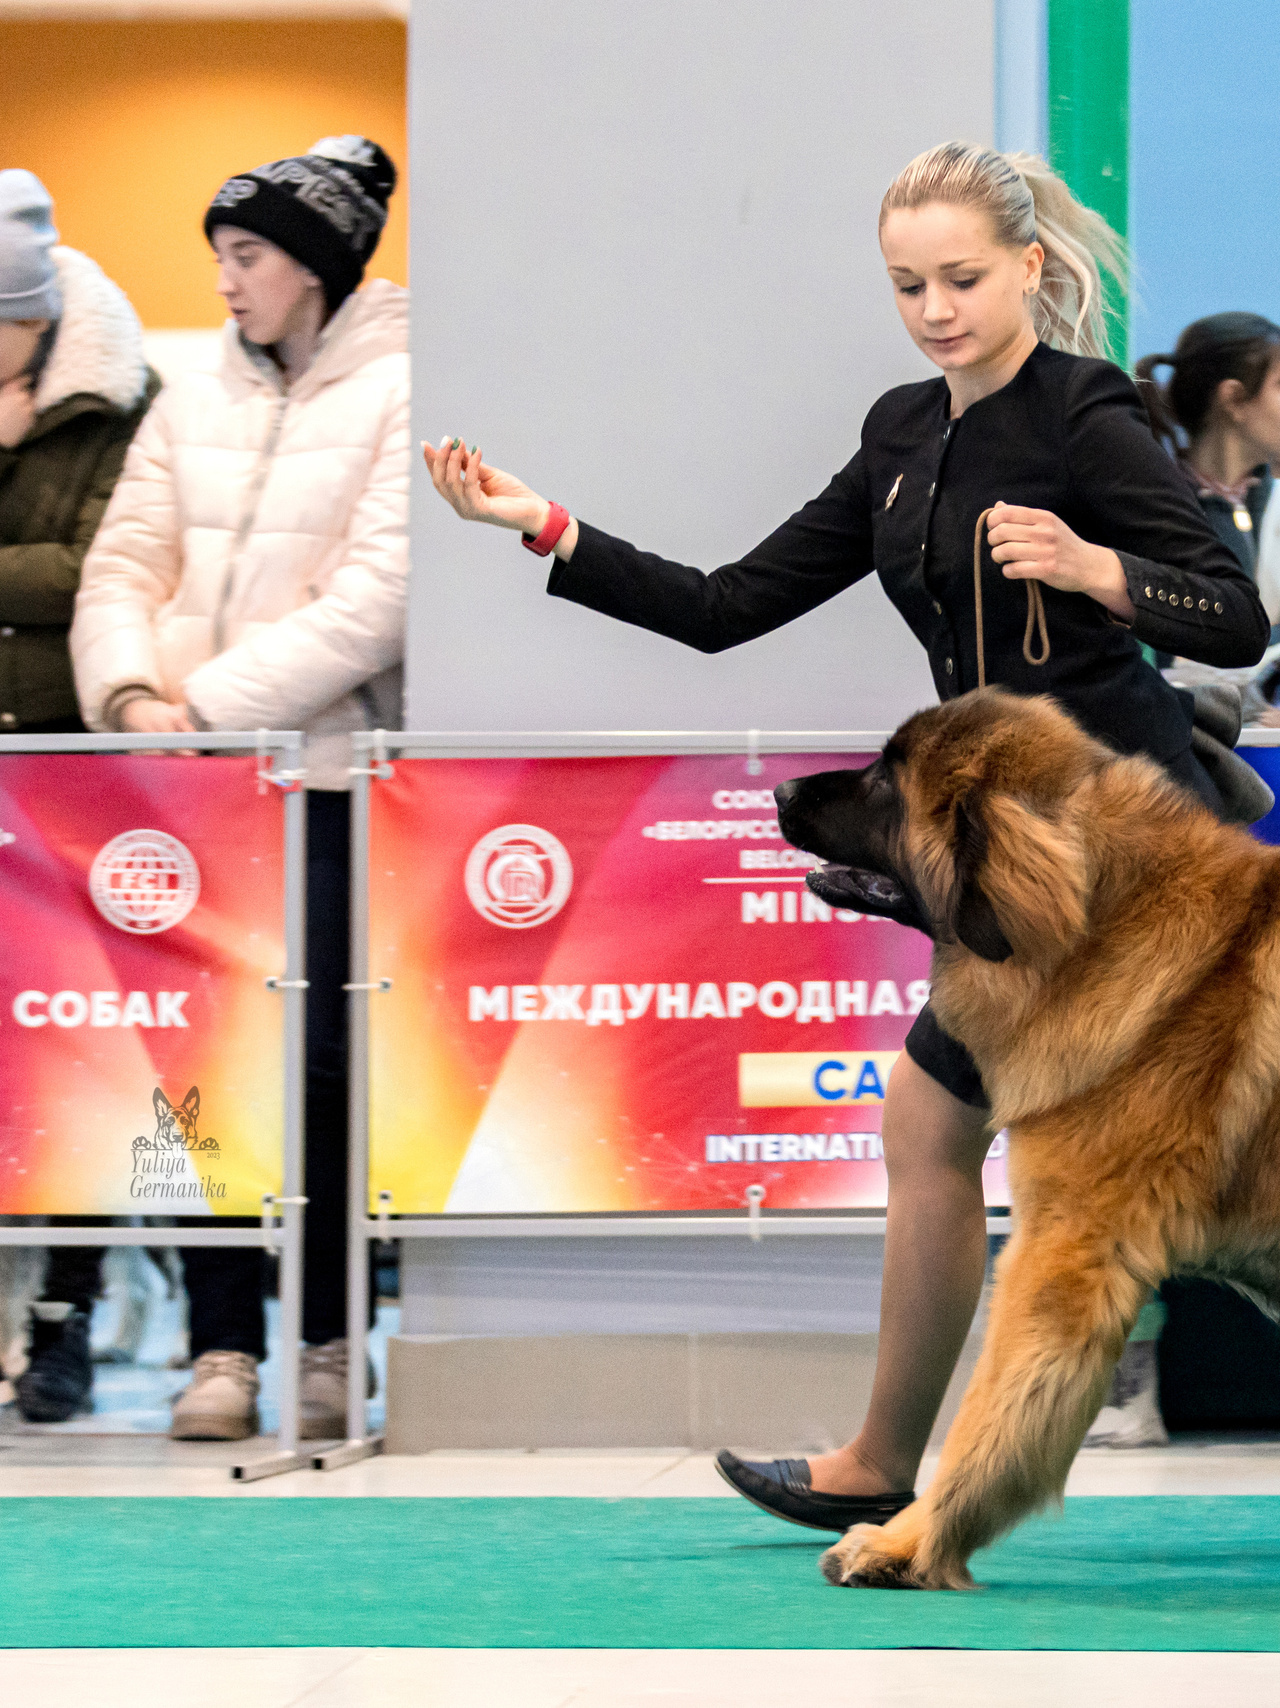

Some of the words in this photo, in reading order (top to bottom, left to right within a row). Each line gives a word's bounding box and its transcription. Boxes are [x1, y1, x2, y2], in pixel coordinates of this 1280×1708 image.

[120, 872, 168, 890] FCI
[12, 990, 190, 1028] СОБАК
[468, 979, 931, 1026] МЕЖДУНАРОДНАЯ
